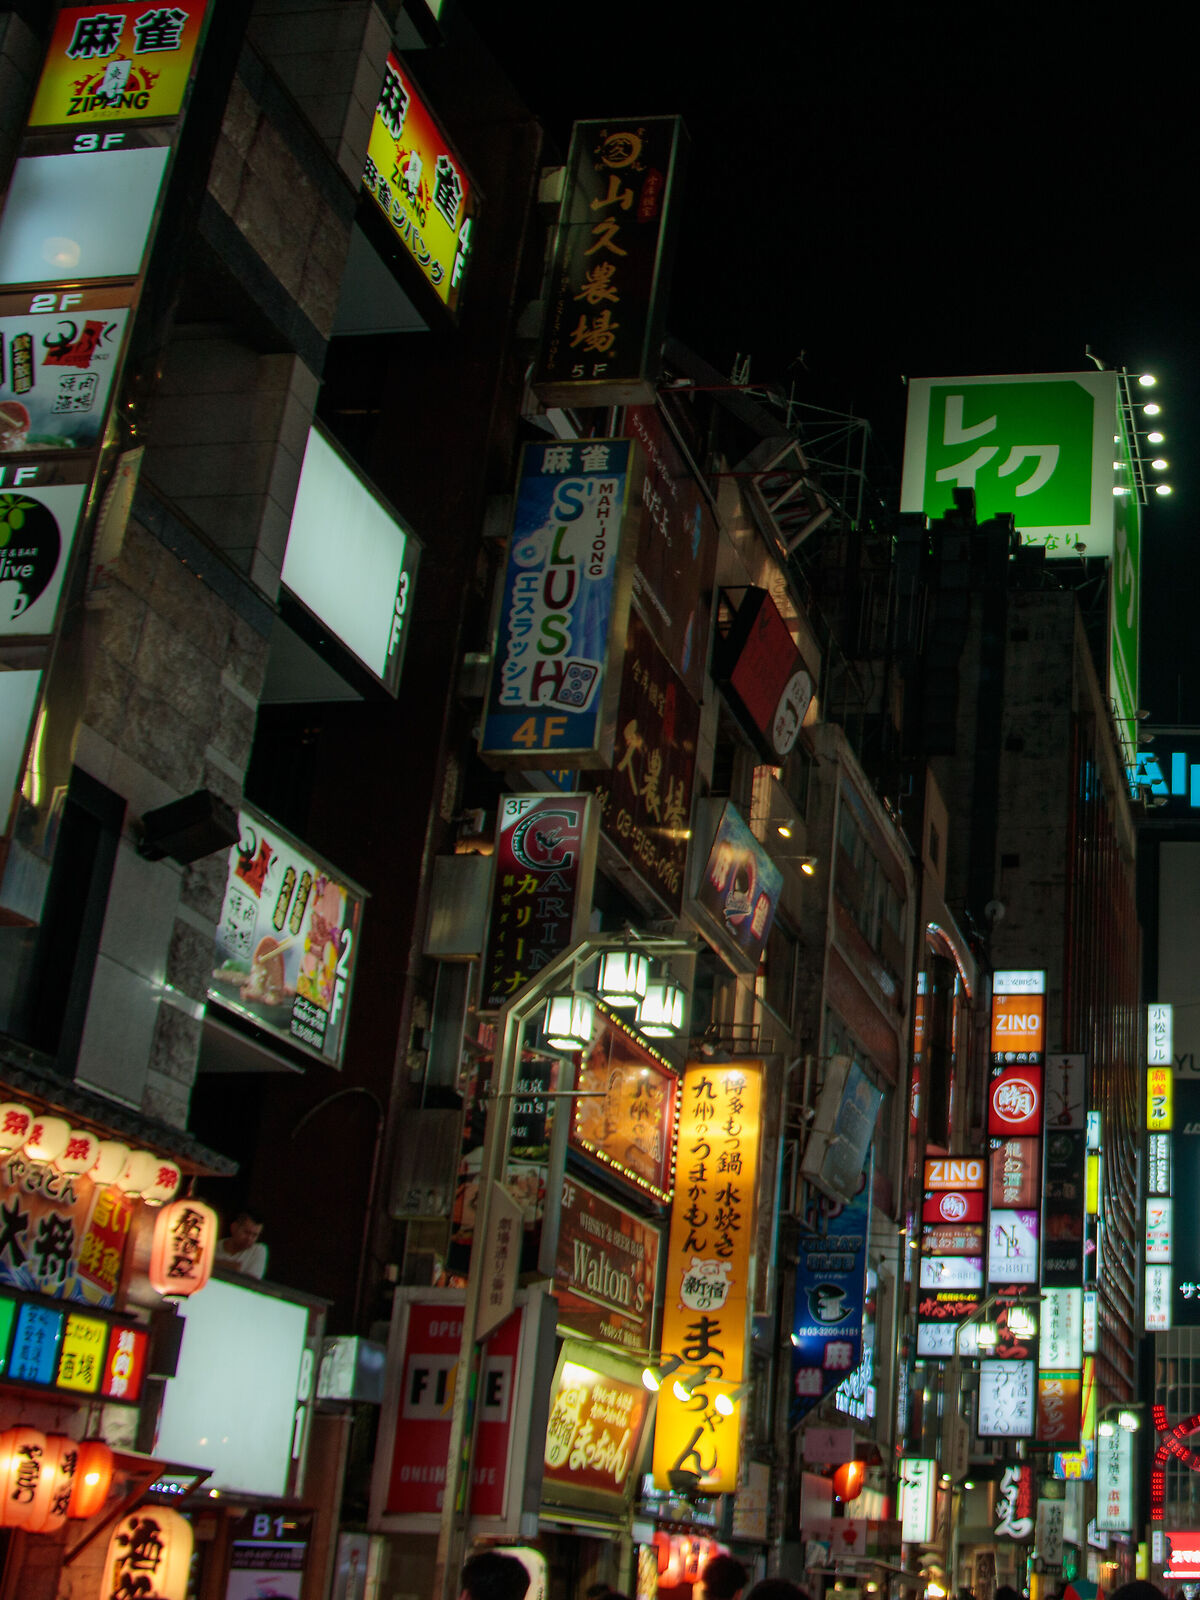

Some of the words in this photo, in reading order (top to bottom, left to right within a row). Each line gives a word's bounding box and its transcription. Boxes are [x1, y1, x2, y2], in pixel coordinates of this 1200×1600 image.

[66, 8, 188, 60] 麻雀
[66, 90, 149, 117] ZIPANG
[73, 133, 125, 152] 3F
[451, 217, 473, 288] 4F
[29, 294, 83, 313] 2F
[570, 363, 608, 378] 5F
[541, 446, 611, 474] 麻雀
[388, 571, 410, 656] 3F
[511, 717, 568, 750] 4F
[505, 800, 530, 816] 3F
[505, 873, 540, 996] カリーナ
[330, 928, 352, 1025] 2F
[996, 1014, 1041, 1031] ZINO
[1152, 1007, 1167, 1062] 小松ビル
[715, 1073, 748, 1177] 博多もつ鍋
[681, 1076, 718, 1253] 九州のうまかもん
[928, 1160, 982, 1181] ZINO
[713, 1182, 743, 1259] 水炊き
[572, 1238, 646, 1313] Walton's
[684, 1277, 726, 1300] 新宿
[411, 1368, 508, 1407] FIE
[401, 1466, 446, 1483] ONLIN
[252, 1513, 285, 1538] B1
